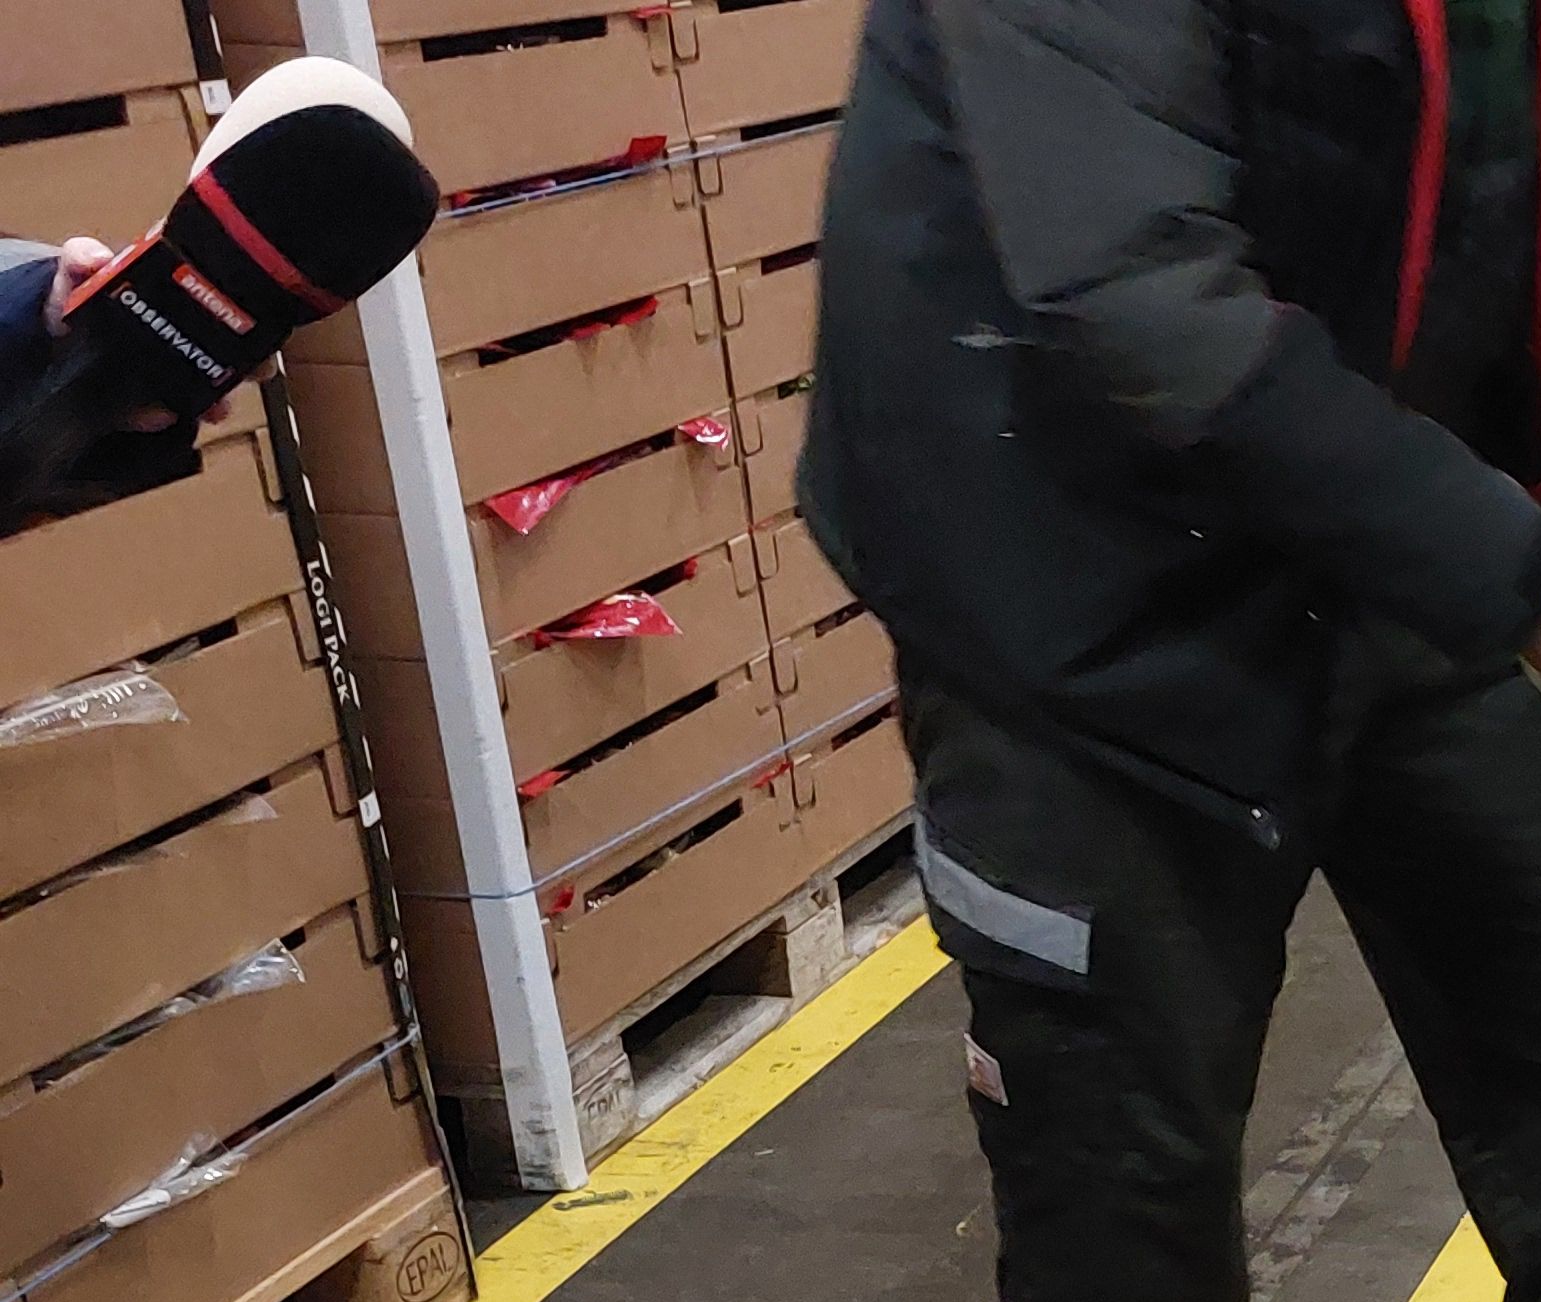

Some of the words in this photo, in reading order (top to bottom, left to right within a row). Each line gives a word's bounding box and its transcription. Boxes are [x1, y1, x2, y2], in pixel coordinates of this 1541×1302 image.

[307, 560, 332, 631] LOGI
[324, 635, 352, 702] PACK
[405, 1242, 452, 1297] EPAL
